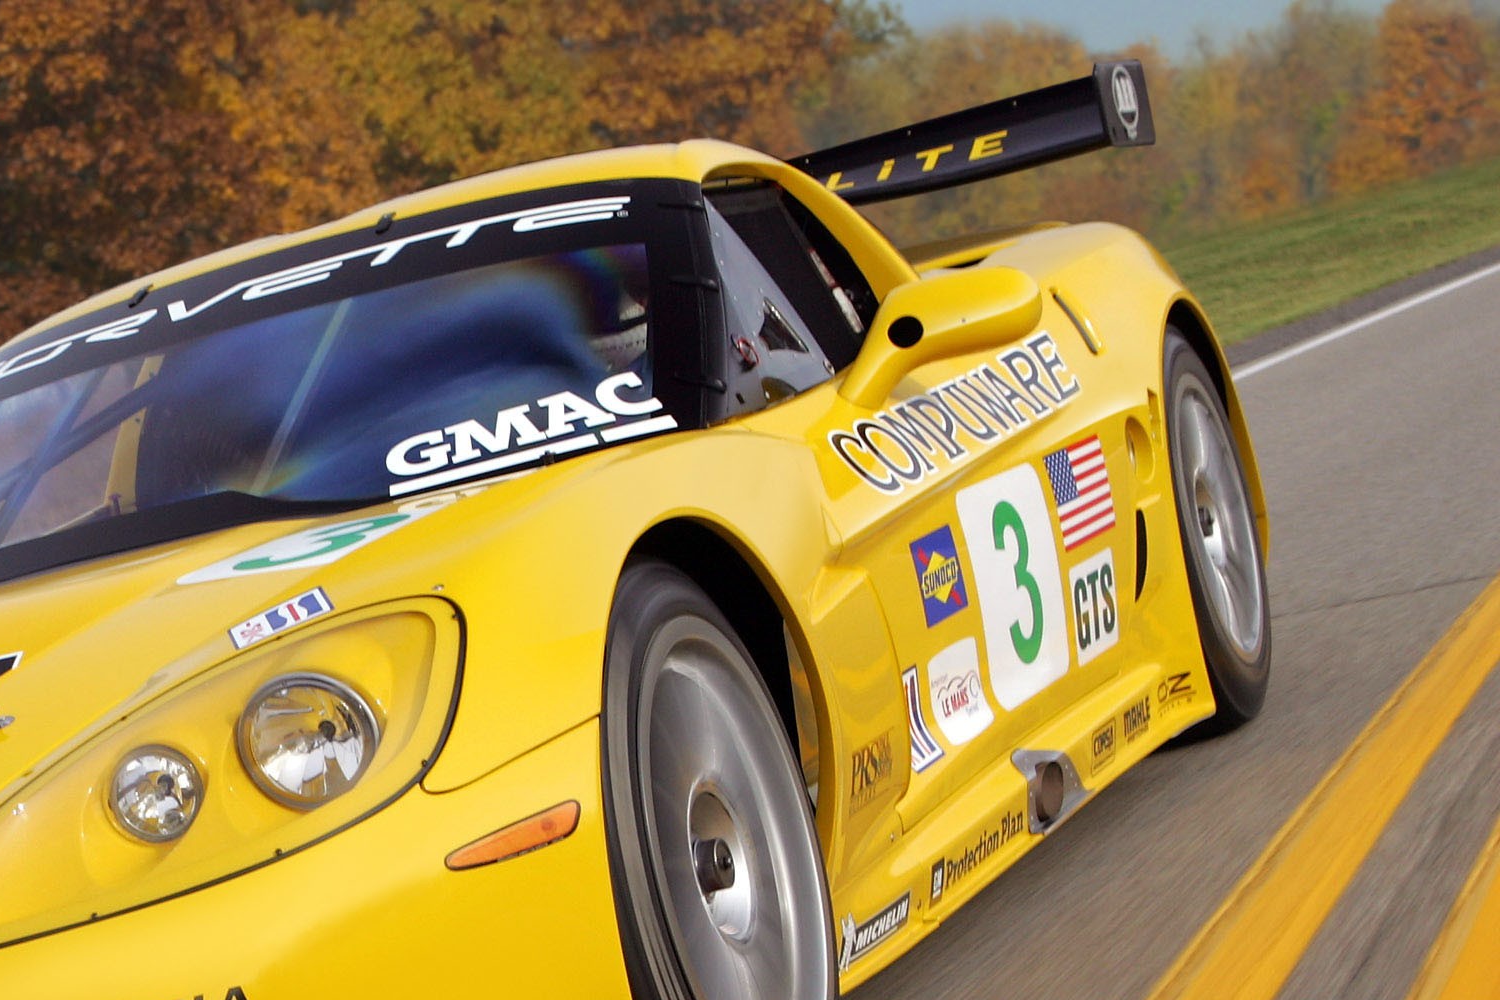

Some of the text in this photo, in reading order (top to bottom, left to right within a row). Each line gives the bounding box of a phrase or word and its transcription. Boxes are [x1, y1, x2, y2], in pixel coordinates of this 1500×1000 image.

[386, 371, 664, 478] GMAC
[828, 330, 1082, 494] COMPUWARE
[923, 560, 957, 596] SUNOCO
[992, 499, 1044, 665] 3
[1073, 562, 1116, 651] GTS
[945, 830, 1000, 890] Protection
[1000, 810, 1025, 846] Plan
[855, 897, 910, 952] MICHELIN
